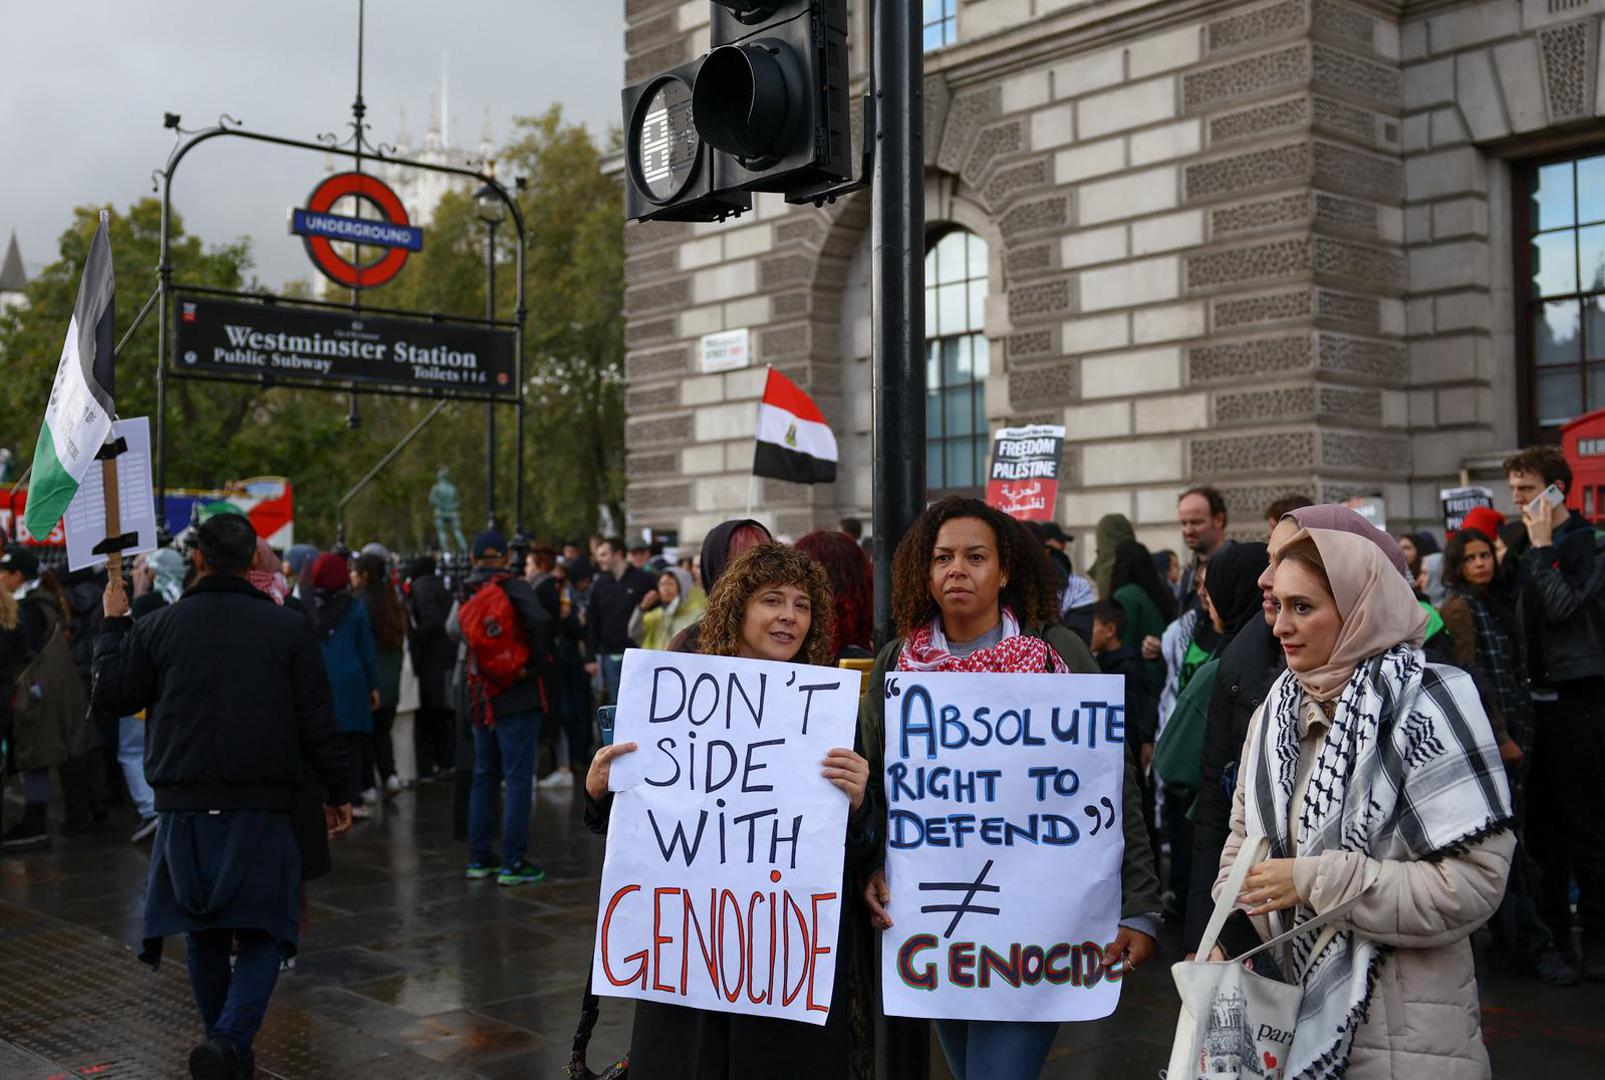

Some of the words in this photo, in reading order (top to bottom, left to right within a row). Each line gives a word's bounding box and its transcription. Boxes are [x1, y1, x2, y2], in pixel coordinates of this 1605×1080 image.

[305, 215, 412, 243] UNDERGROUND
[224, 325, 386, 360] Westminster
[393, 341, 477, 368] Station
[213, 347, 267, 366] Public
[271, 352, 333, 374] Subway
[412, 365, 460, 383] Toilets
[999, 438, 1055, 456] FREEDOM
[992, 461, 1056, 479] PALESTINE
[648, 666, 841, 735] DON'T
[887, 762, 1002, 803] RIGHT
[1028, 766, 1080, 802] TO
